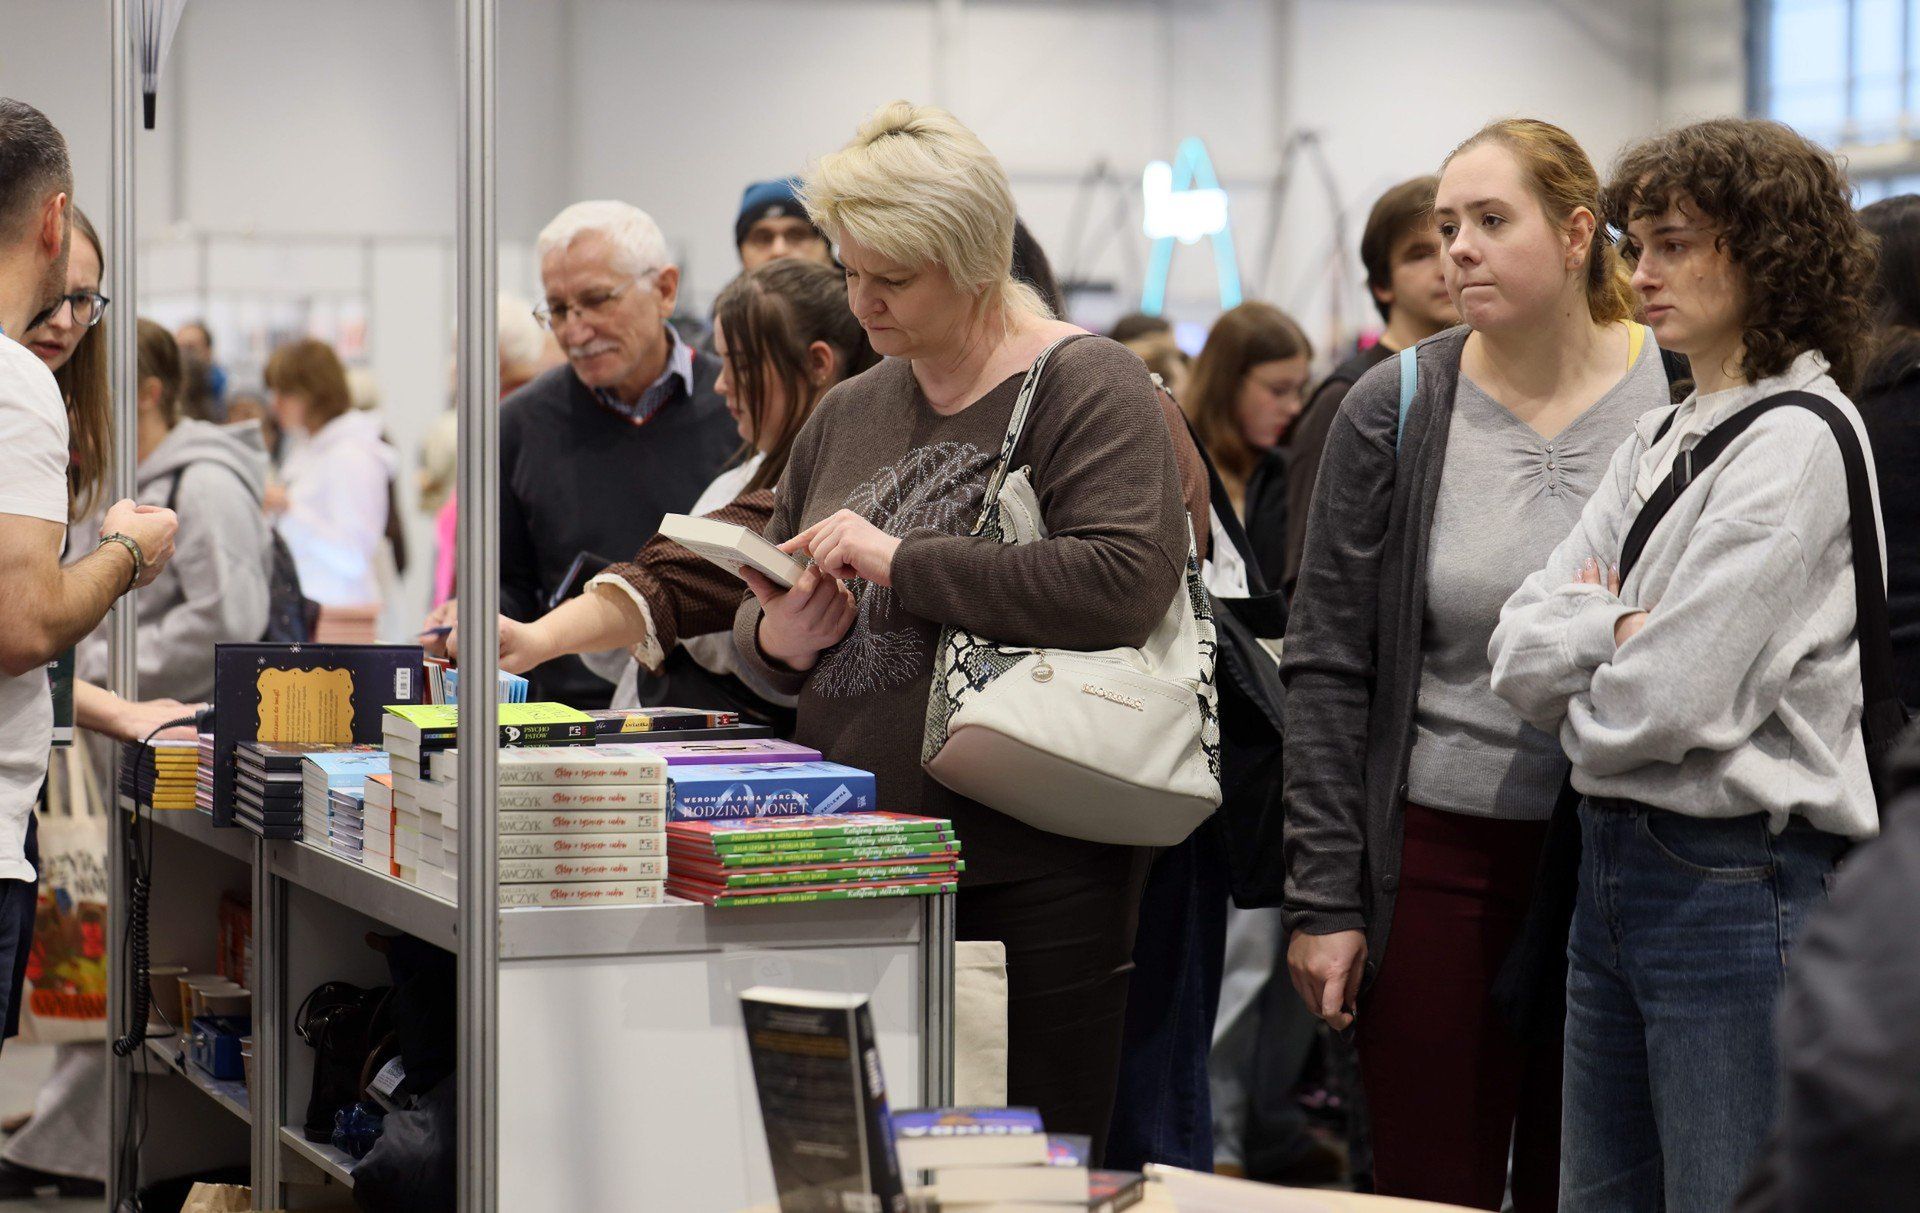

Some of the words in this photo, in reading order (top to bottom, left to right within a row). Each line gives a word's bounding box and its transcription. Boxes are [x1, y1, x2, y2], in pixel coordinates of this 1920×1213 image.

[500, 771, 544, 782] AWCZYK
[683, 794, 733, 803] WERONIKA
[765, 792, 809, 801] MARCZAK
[683, 803, 750, 817] RODZINA
[755, 801, 809, 816] MONET
[500, 844, 542, 855] AWCZYK
[500, 868, 544, 880] AWCZYK
